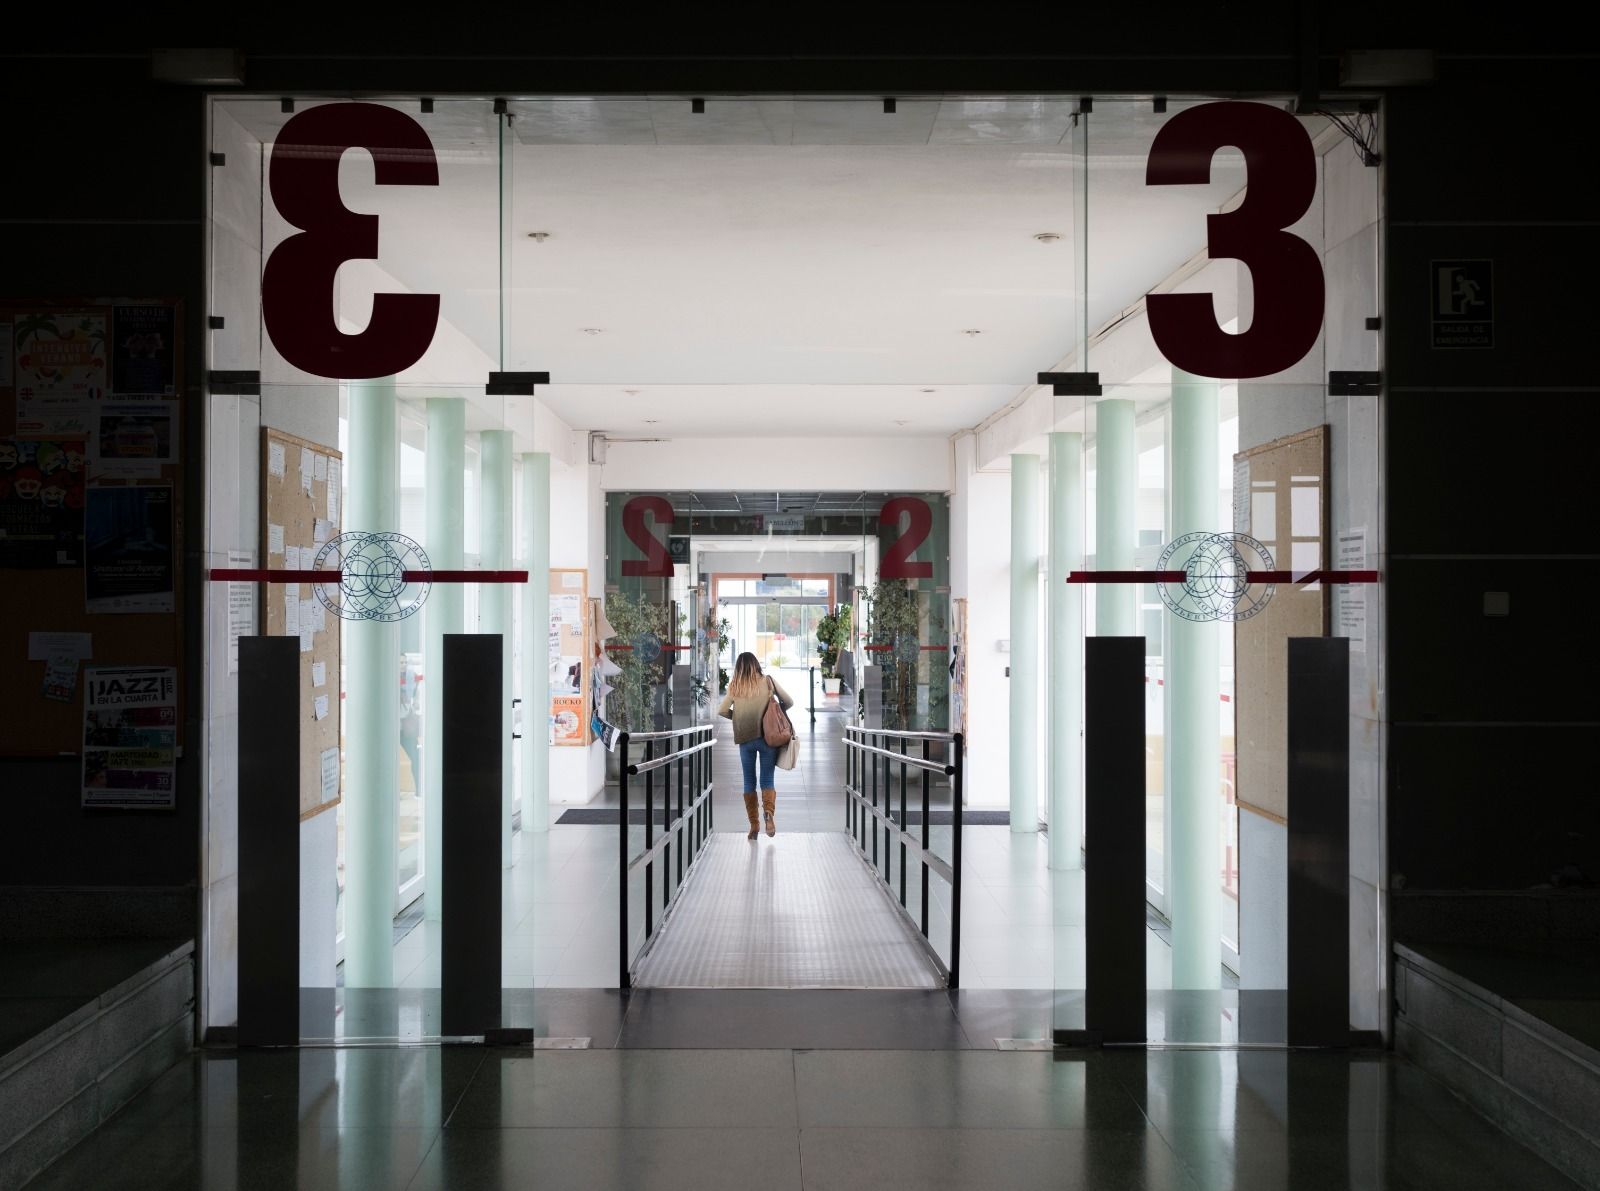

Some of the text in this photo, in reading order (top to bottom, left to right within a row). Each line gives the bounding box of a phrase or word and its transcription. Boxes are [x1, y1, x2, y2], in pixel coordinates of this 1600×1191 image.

[1146, 100, 1325, 379] 3
[1440, 325, 1489, 333] SALIDA DE
[880, 497, 933, 578] 2
[97, 677, 159, 695] JAZZ
[97, 694, 159, 705] EN LA CUARTA
